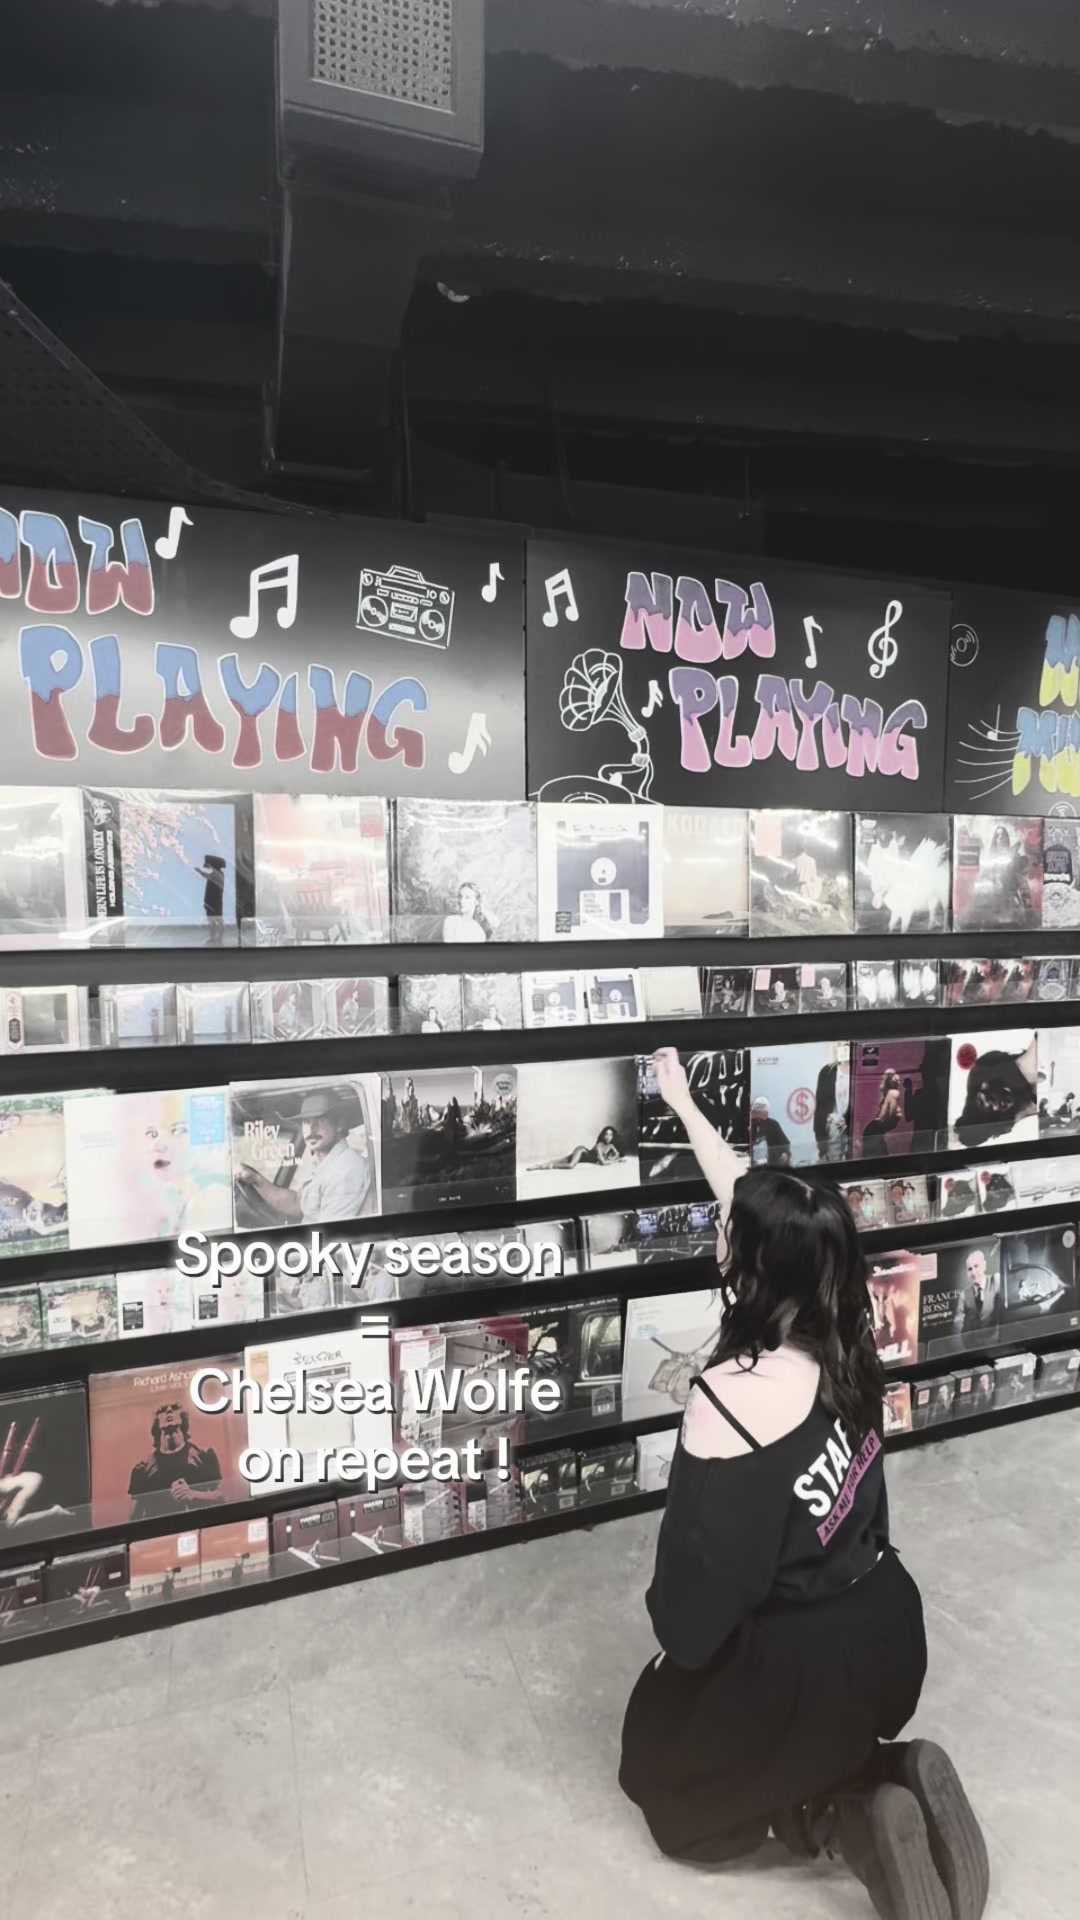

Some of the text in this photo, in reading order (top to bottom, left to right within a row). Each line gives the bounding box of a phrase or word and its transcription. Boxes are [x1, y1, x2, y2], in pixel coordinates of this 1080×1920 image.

[620, 572, 776, 663] NOW
[19, 624, 430, 774] PLAYING
[668, 666, 928, 781] PLAYING
[92, 829, 105, 864] LONELY
[95, 865, 106, 874] IS
[95, 874, 107, 896] LIFE
[244, 1120, 281, 1143] Riley
[252, 1141, 296, 1161] Green
[922, 1289, 961, 1305] FRANCIS
[922, 1301, 949, 1314] ROSSI
[133, 1369, 197, 1387] Richard Ashc
[823, 1436, 877, 1538] ASK ME FOR HELP
